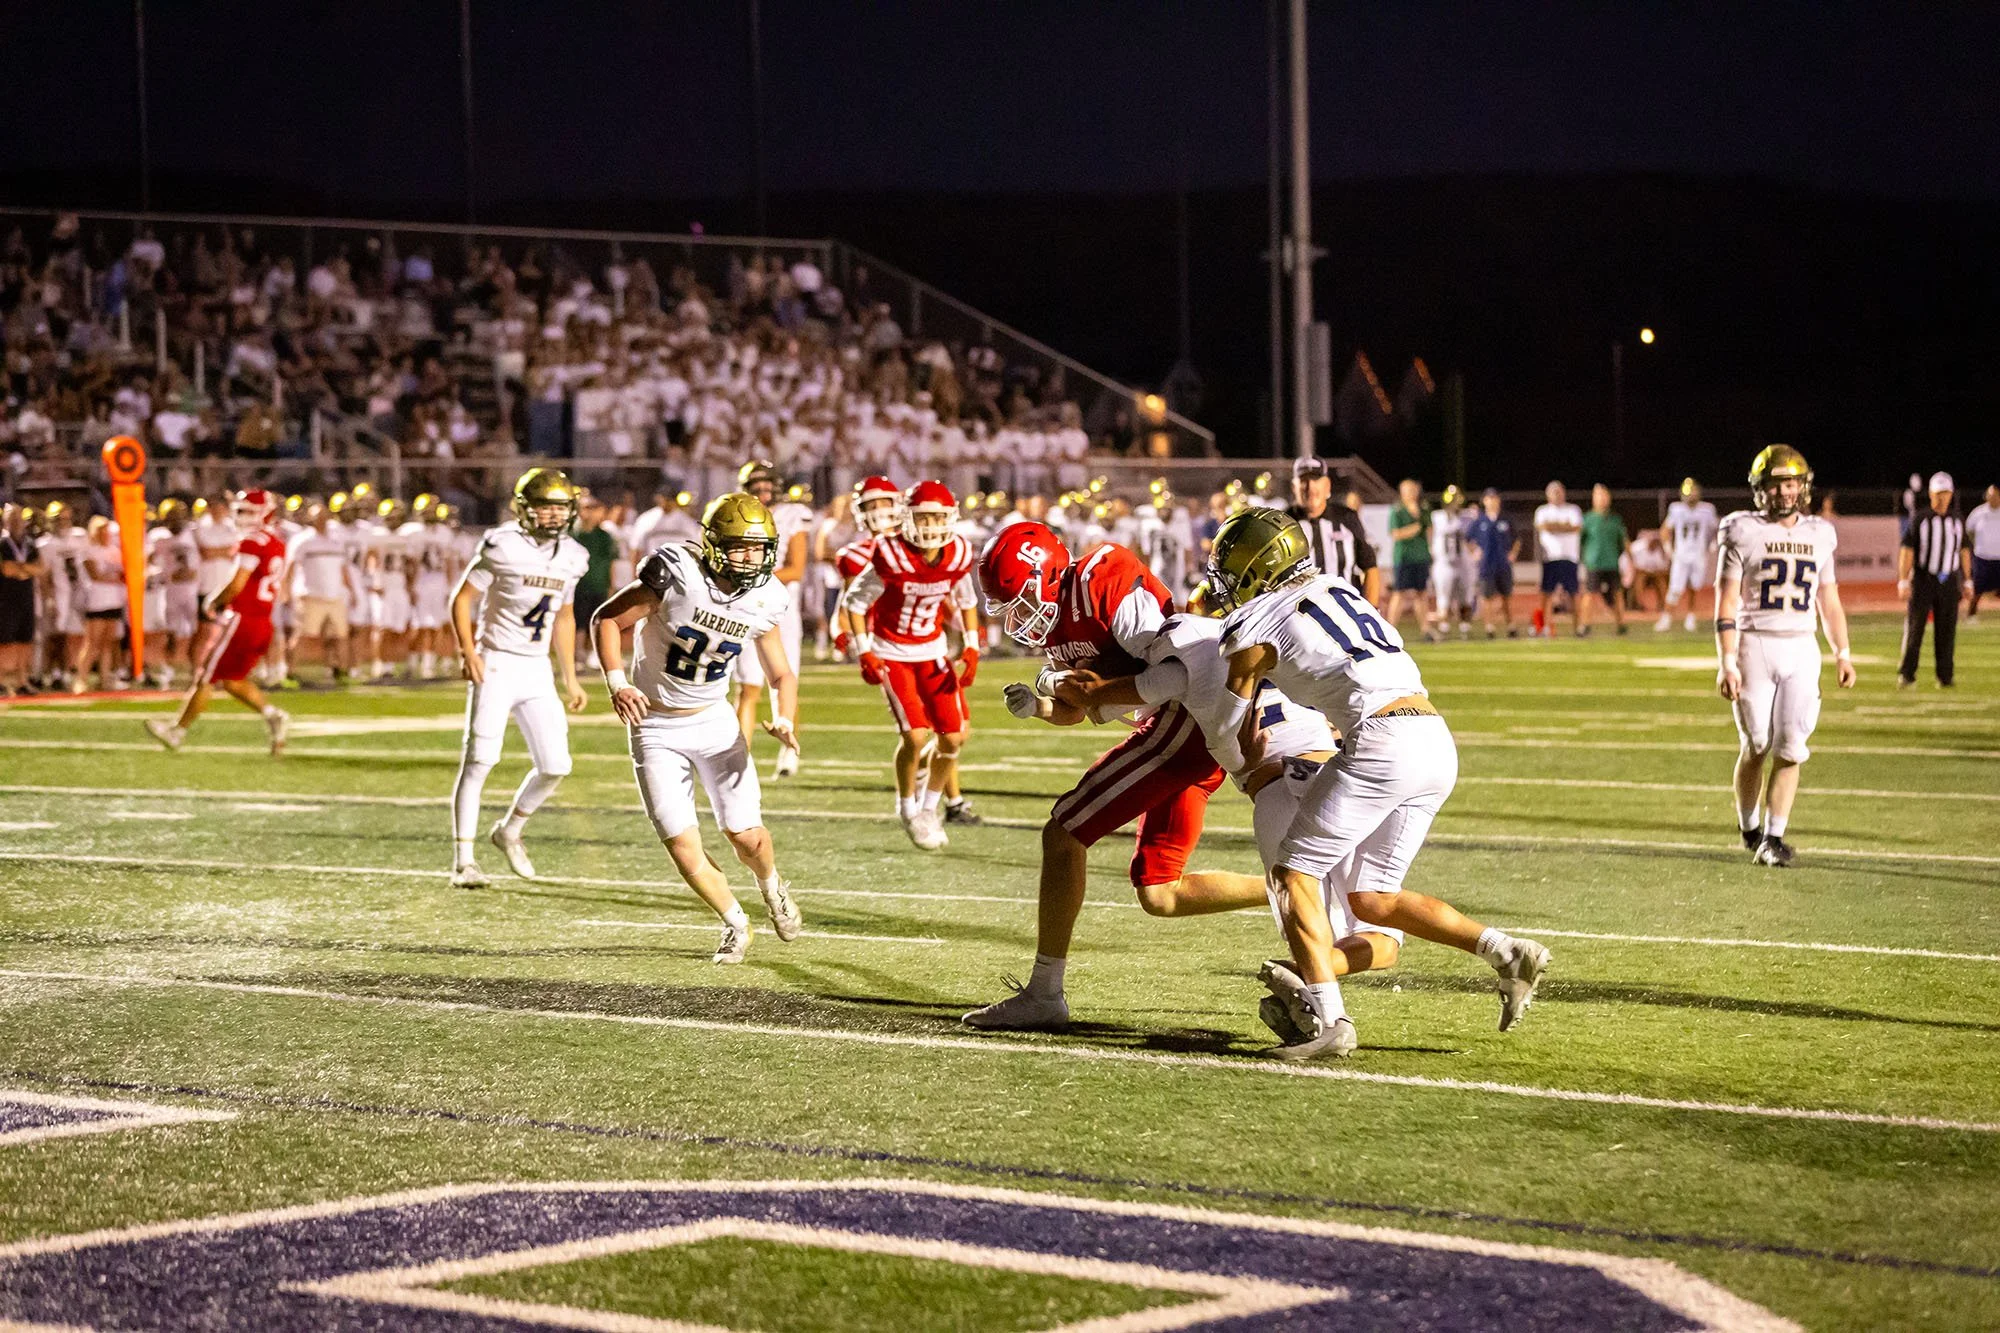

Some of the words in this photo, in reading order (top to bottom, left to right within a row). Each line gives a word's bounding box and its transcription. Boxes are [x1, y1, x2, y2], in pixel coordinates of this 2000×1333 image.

[1016, 541, 1048, 567] 16
[1764, 542, 1814, 556] WARRIORS
[1760, 558, 1817, 612] 25
[522, 593, 555, 642] 4
[691, 606, 750, 639] WARRIORS
[1296, 586, 1401, 663] 16
[664, 625, 743, 683] 22
[1044, 640, 1100, 662] CRIMSON
